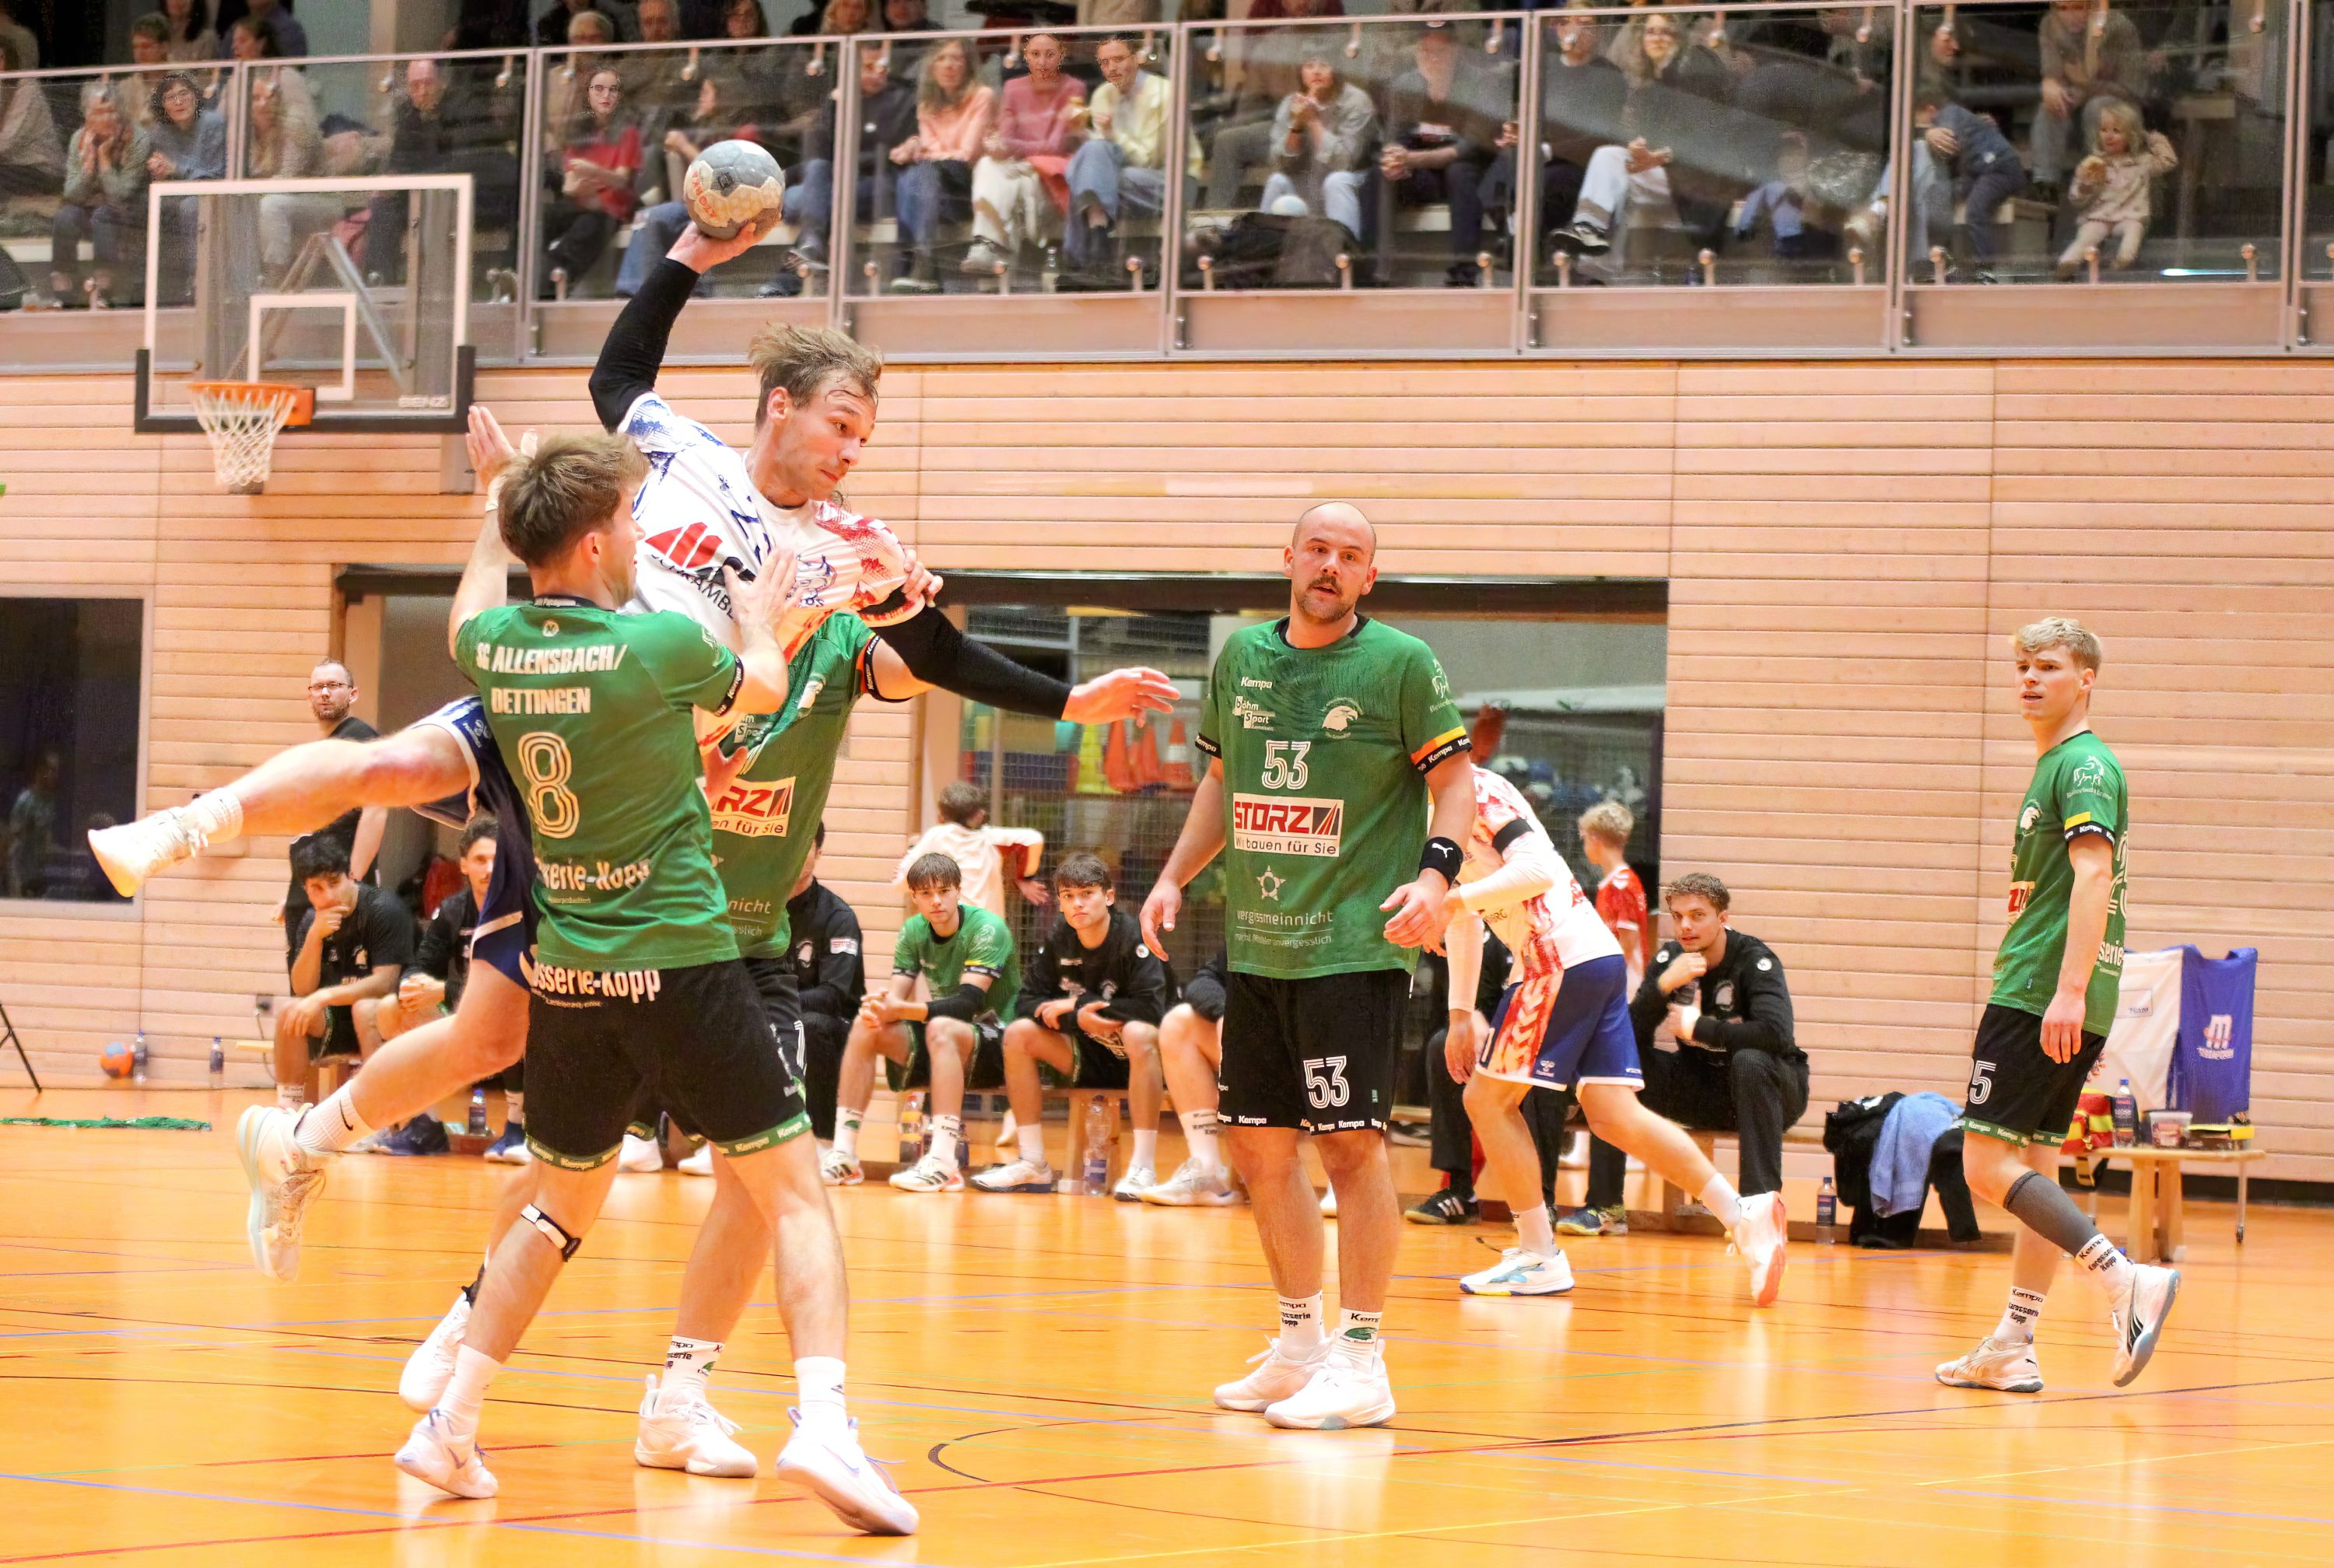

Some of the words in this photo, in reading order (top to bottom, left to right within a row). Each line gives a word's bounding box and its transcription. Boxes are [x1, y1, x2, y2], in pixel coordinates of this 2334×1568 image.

[492, 644, 629, 675] ALLENSBACH/
[1240, 676, 1273, 691] Kempa
[491, 687, 591, 715] DETTINGEN
[1235, 697, 1259, 712] böhm
[1245, 711, 1270, 725] Sport
[1428, 745, 1453, 763] Kempa
[1261, 739, 1312, 790] 53
[517, 731, 580, 839] 8
[1234, 800, 1312, 835] STORZ
[1246, 838, 1282, 852] bauen
[1288, 840, 1309, 853] für
[1314, 842, 1337, 855] Sie
[728, 897, 772, 915] nicht
[1237, 908, 1333, 926] vergissmeinnicht
[1302, 1055, 1351, 1110] 53
[1238, 1115, 1267, 1126] Kempa
[1338, 1119, 1365, 1129] Kempa
